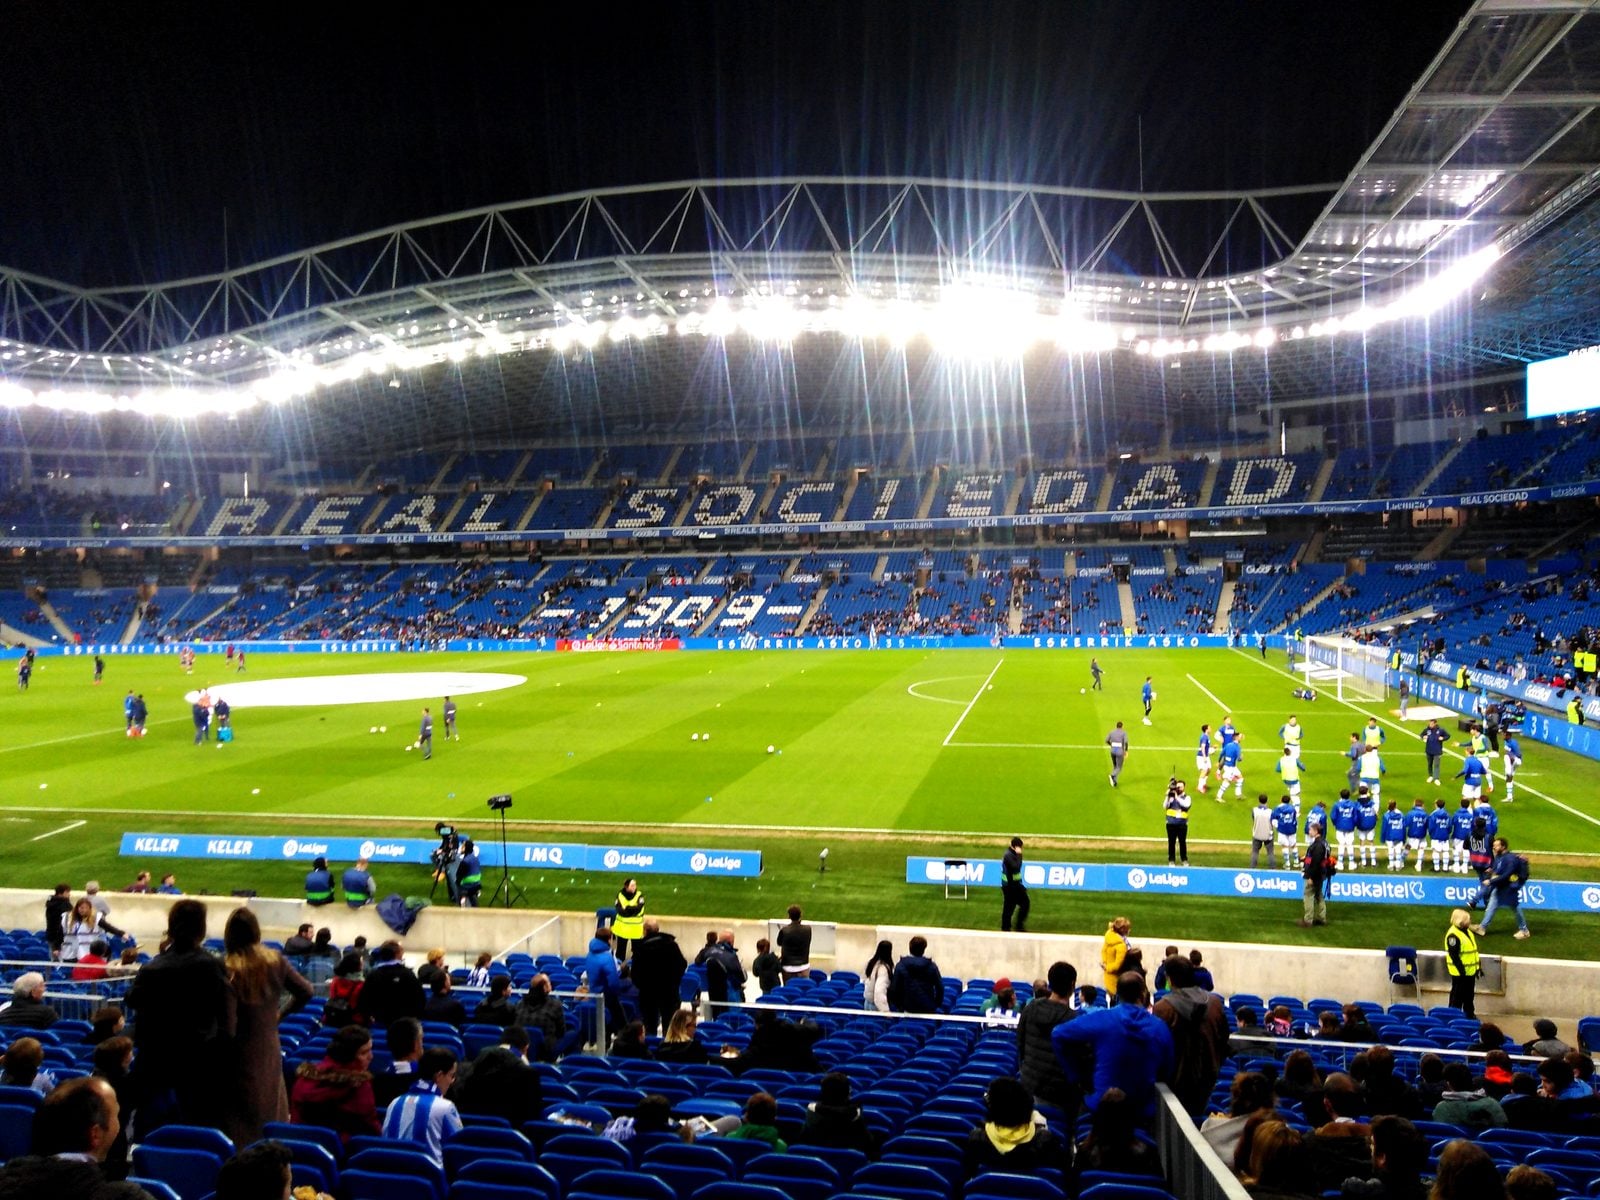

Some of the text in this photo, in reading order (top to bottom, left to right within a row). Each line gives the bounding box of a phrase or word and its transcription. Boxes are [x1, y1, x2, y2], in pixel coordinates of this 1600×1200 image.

[205, 457, 1297, 536] REAL SOCIEDAD
[1460, 492, 1528, 505] REAL SOCIEDAD
[968, 518, 998, 527] KELER
[1012, 517, 1044, 525] KELER
[387, 535, 414, 543] KELER
[427, 534, 454, 542] KELER
[321, 643, 397, 652] ESKERRIK
[717, 639, 804, 649] ESKRRIK
[817, 639, 862, 649] ASKO
[1034, 637, 1132, 648] ESKERRIK
[1148, 636, 1199, 647] ASKO
[64, 645, 144, 655] ESKERRIK
[135, 837, 180, 852] KELER
[207, 839, 253, 854] KELER
[299, 842, 328, 855] LaLiga
[375, 844, 406, 857] LaLiga
[524, 847, 563, 864] IMQ
[620, 852, 653, 866] LaLiga
[707, 856, 741, 870] LaLiga
[1048, 866, 1085, 887] BM
[1148, 872, 1188, 887] LaLiga
[1256, 877, 1297, 893] LaLiga
[1330, 880, 1409, 899] euskaltel
